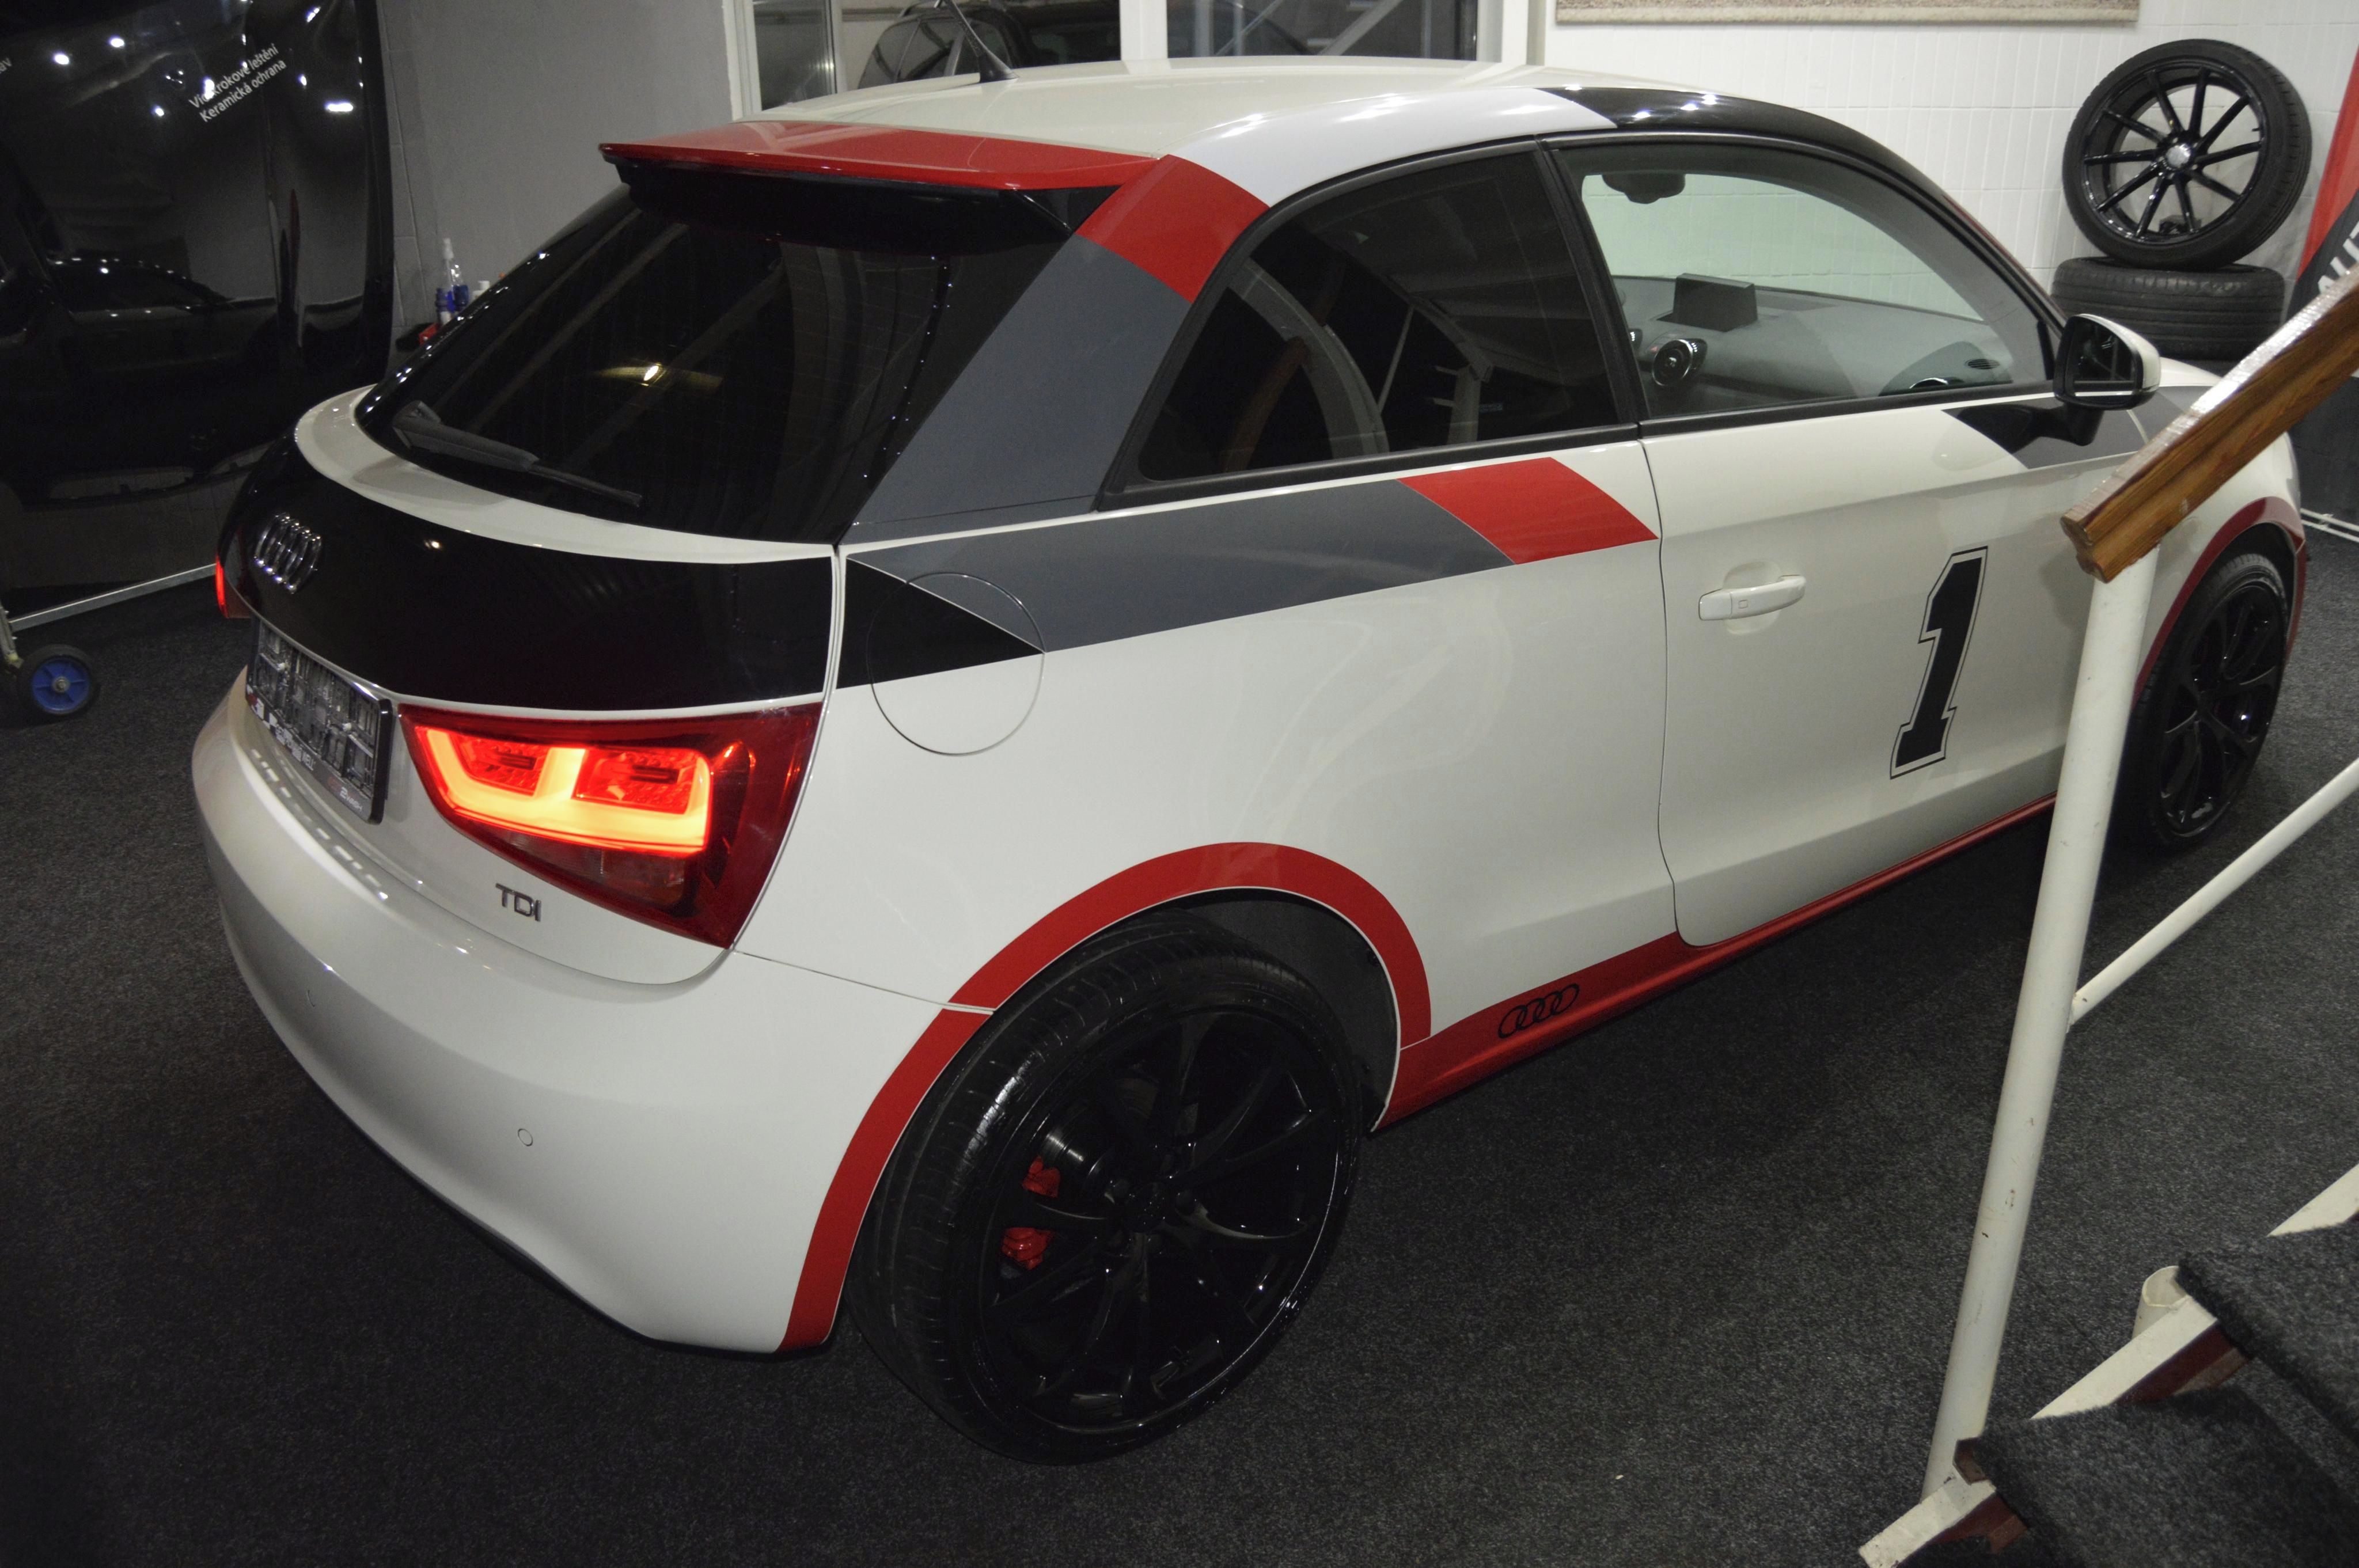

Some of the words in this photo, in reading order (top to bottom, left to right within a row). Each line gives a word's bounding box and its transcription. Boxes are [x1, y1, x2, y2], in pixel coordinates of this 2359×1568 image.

[188, 63, 251, 108] Víckrokové
[199, 82, 253, 123] Keramická
[251, 60, 287, 88] ochrana
[1890, 546, 1988, 780] 1
[495, 883, 541, 922] TDI
